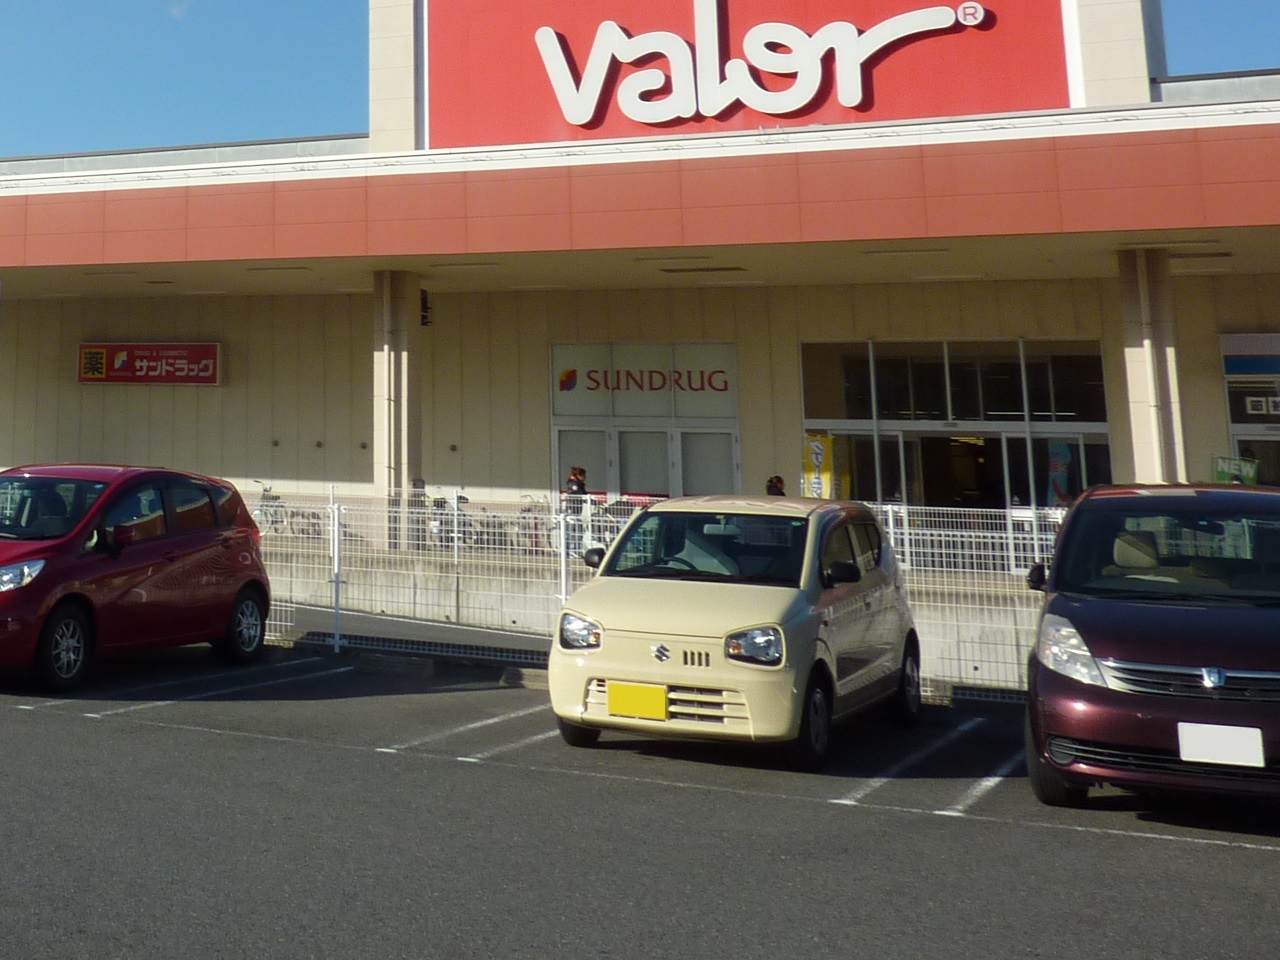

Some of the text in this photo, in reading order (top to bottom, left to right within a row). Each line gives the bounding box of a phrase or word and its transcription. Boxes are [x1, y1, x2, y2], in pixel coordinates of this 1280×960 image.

[134, 358, 214, 376] サンドラッグ
[586, 369, 729, 392] SUNDRUG
[1217, 458, 1256, 477] NEW
